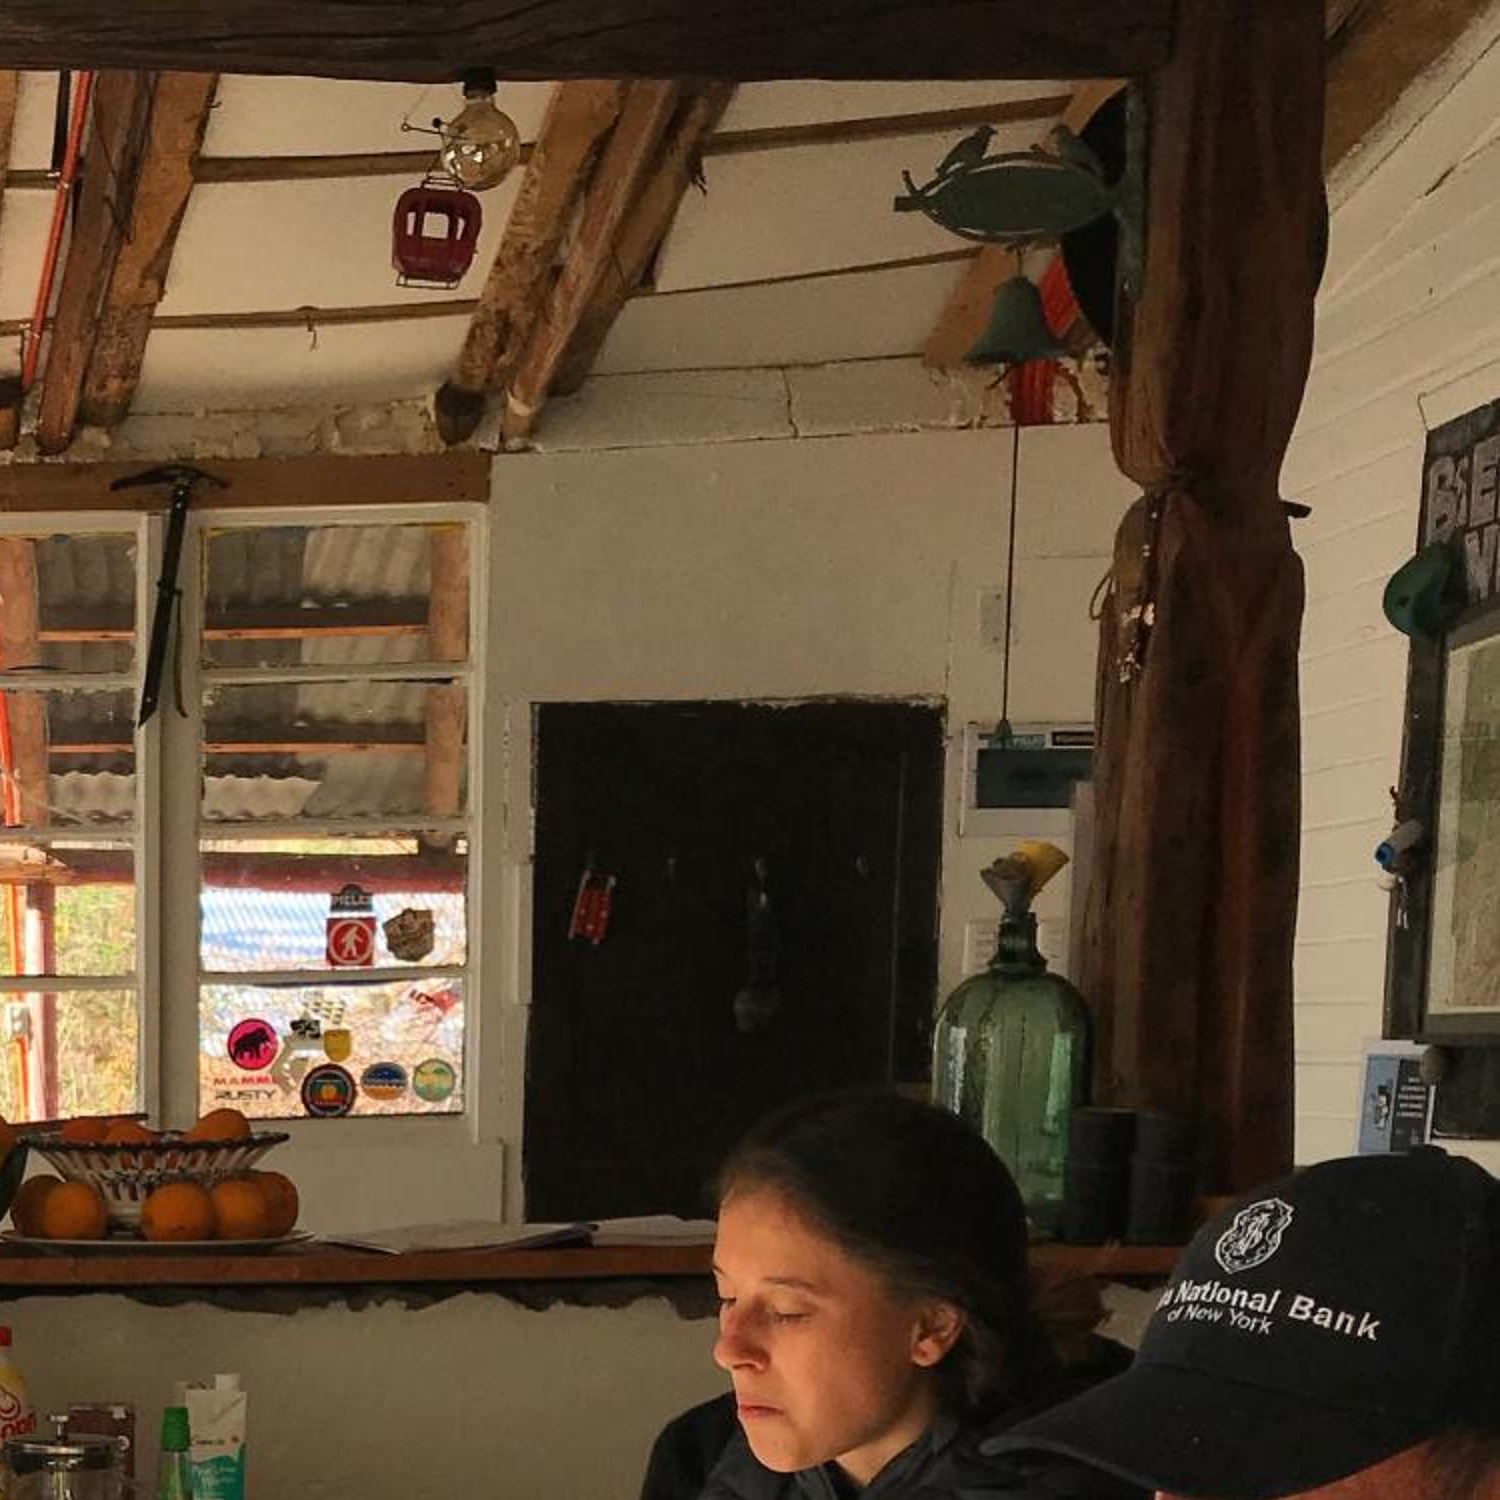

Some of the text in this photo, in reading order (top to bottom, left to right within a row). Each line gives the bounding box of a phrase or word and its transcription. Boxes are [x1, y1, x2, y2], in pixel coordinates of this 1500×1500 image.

[1167, 1303, 1274, 1336] of New York
[1174, 1278, 1281, 1314] National
[1288, 1294, 1381, 1341] Bank
